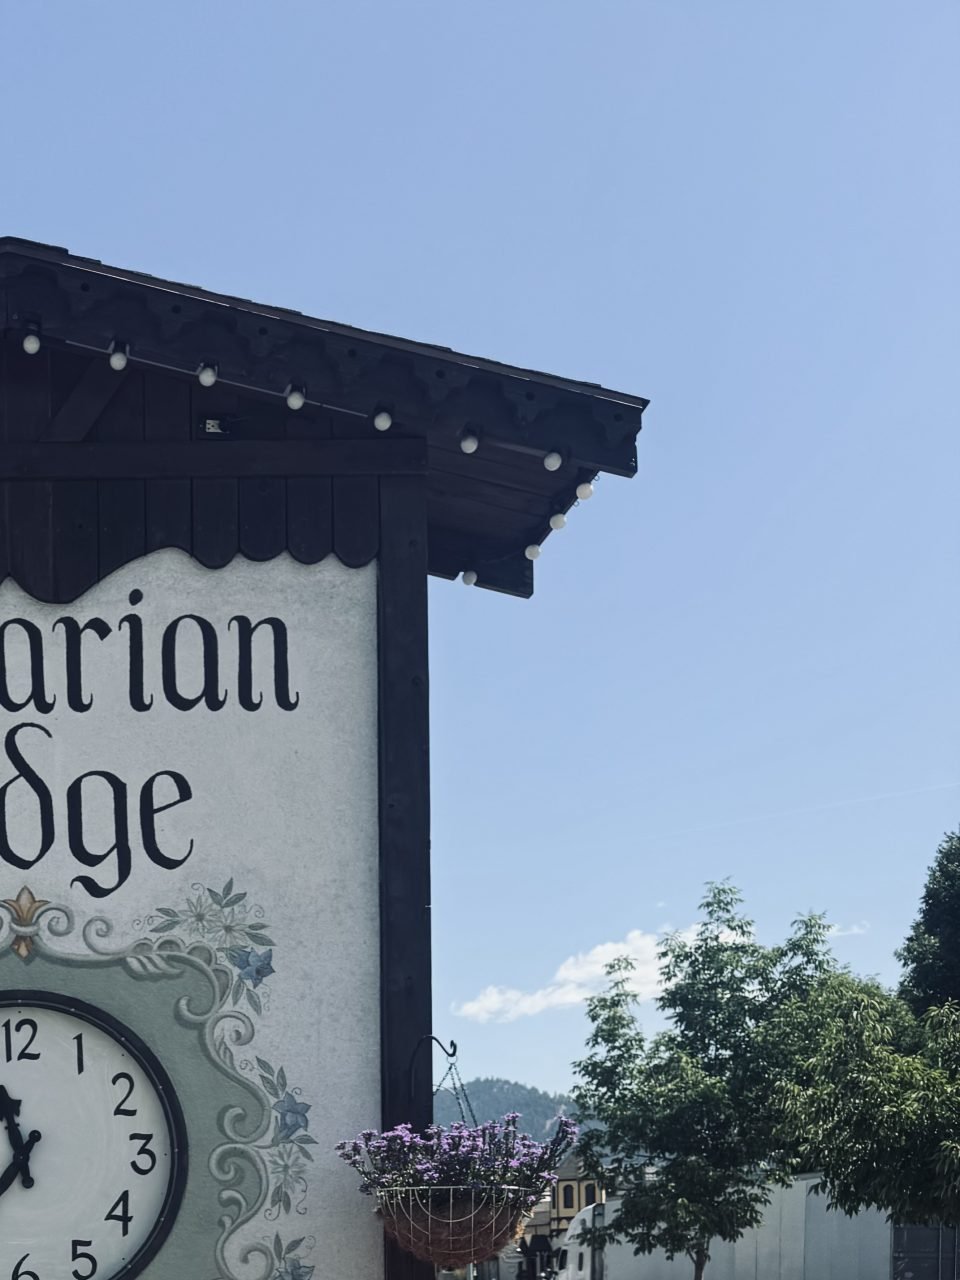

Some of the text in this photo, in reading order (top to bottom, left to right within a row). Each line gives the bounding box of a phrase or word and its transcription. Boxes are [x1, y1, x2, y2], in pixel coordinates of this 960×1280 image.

[1, 1018, 41, 1063] 12
[72, 1032, 85, 1075] 1
[111, 1071, 138, 1117] 2
[128, 1132, 157, 1176] 3
[103, 1189, 134, 1238] 4
